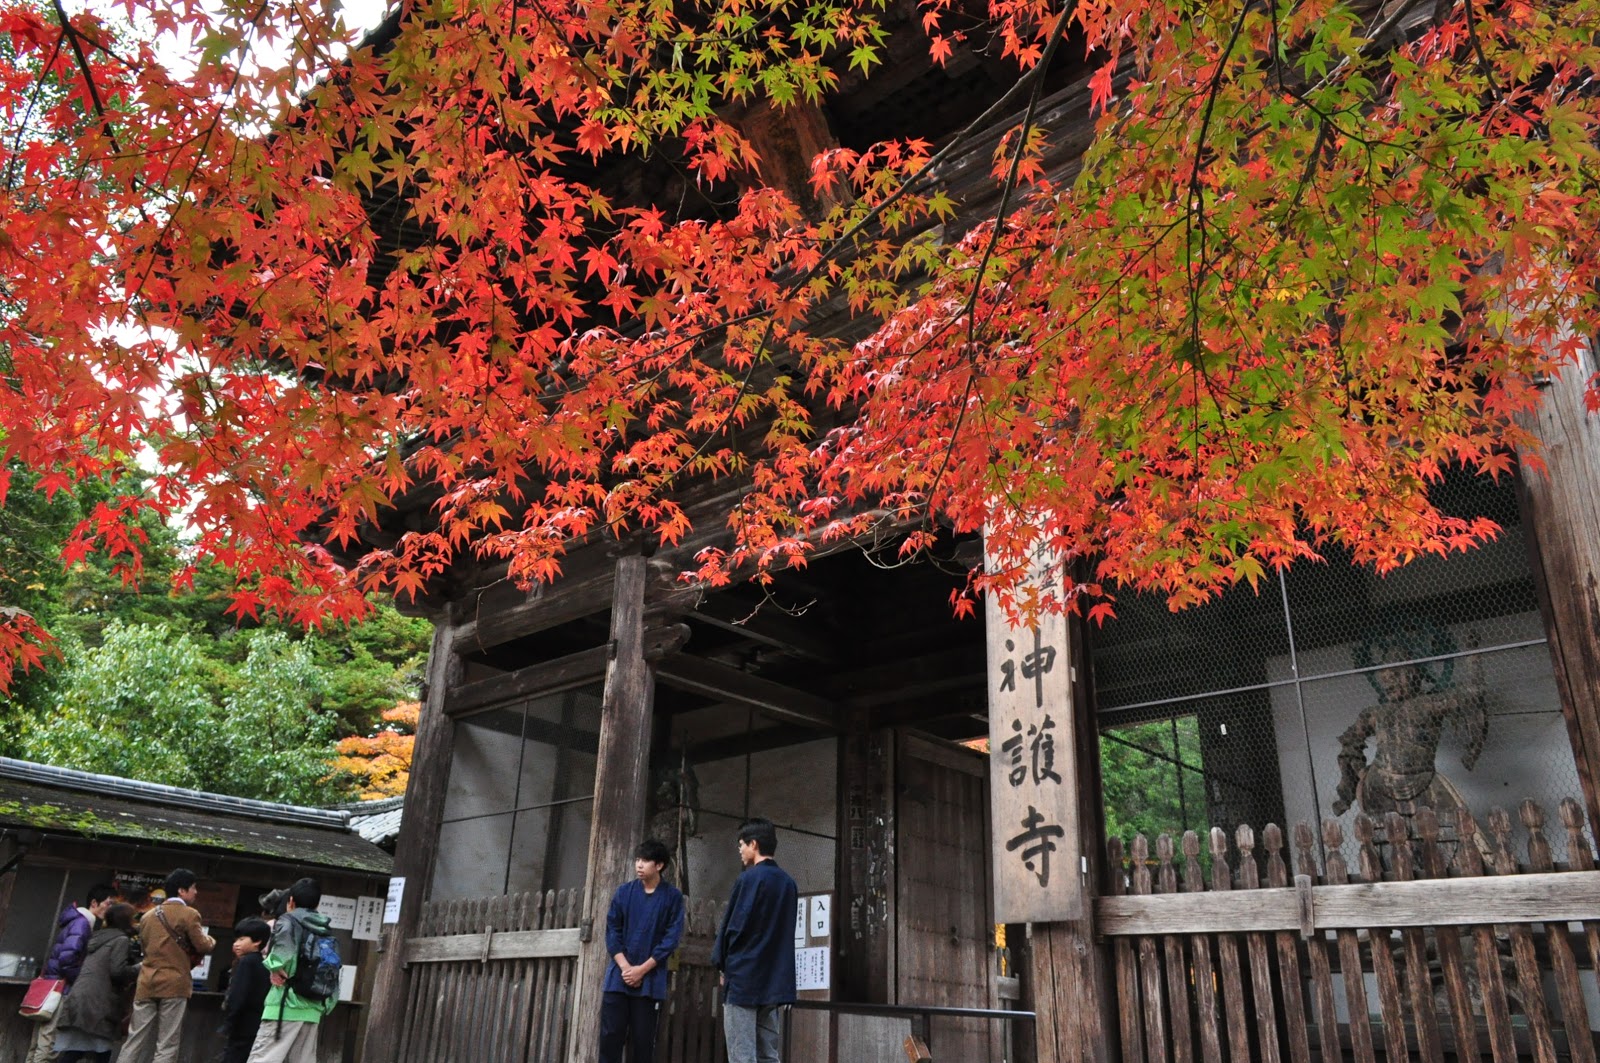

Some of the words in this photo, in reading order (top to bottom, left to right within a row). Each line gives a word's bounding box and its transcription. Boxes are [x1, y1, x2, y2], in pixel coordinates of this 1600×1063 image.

[1000, 626, 1065, 888] 神護寺
[818, 900, 825, 929] 入口
